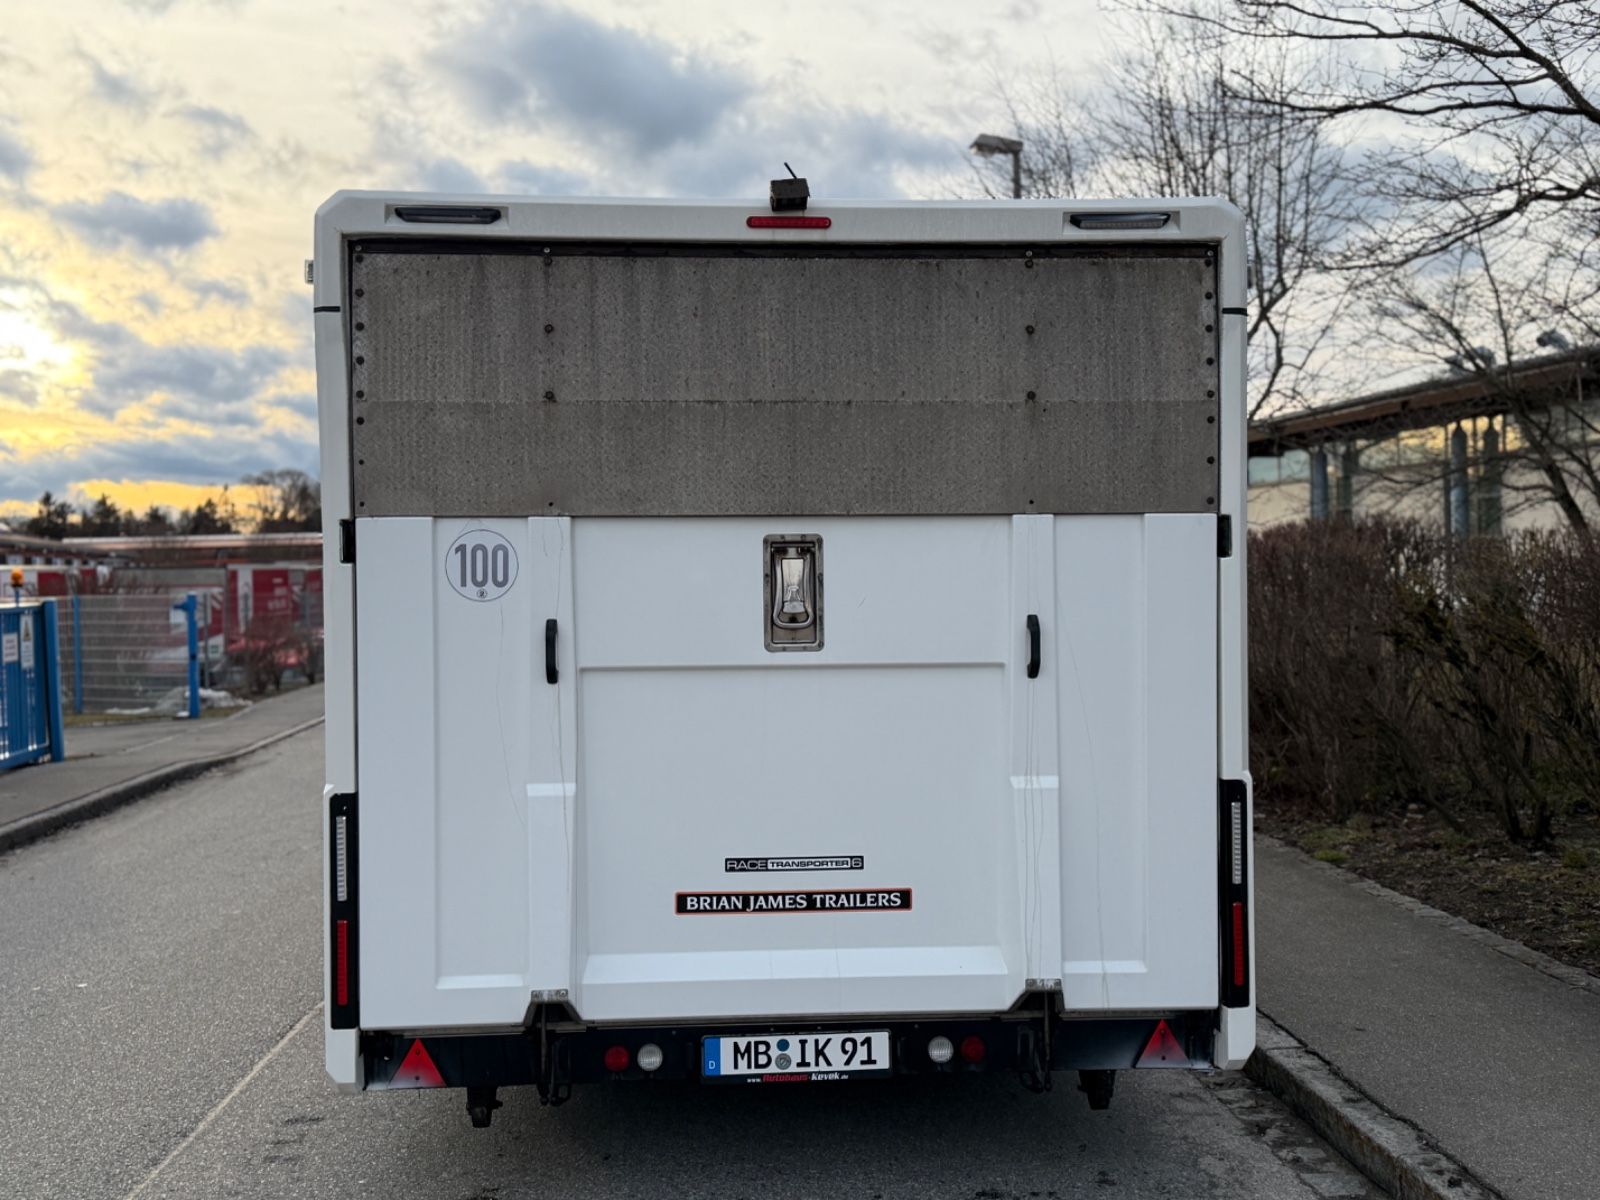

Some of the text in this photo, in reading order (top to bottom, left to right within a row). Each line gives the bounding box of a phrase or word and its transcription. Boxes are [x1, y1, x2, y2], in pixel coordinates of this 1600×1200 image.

[455, 543, 509, 588] 100
[726, 858, 862, 870] RACE TRANSPORTER 6
[686, 892, 902, 912] BRIAN JAMES TRAILERS
[708, 1036, 877, 1070] D MB IK 91
